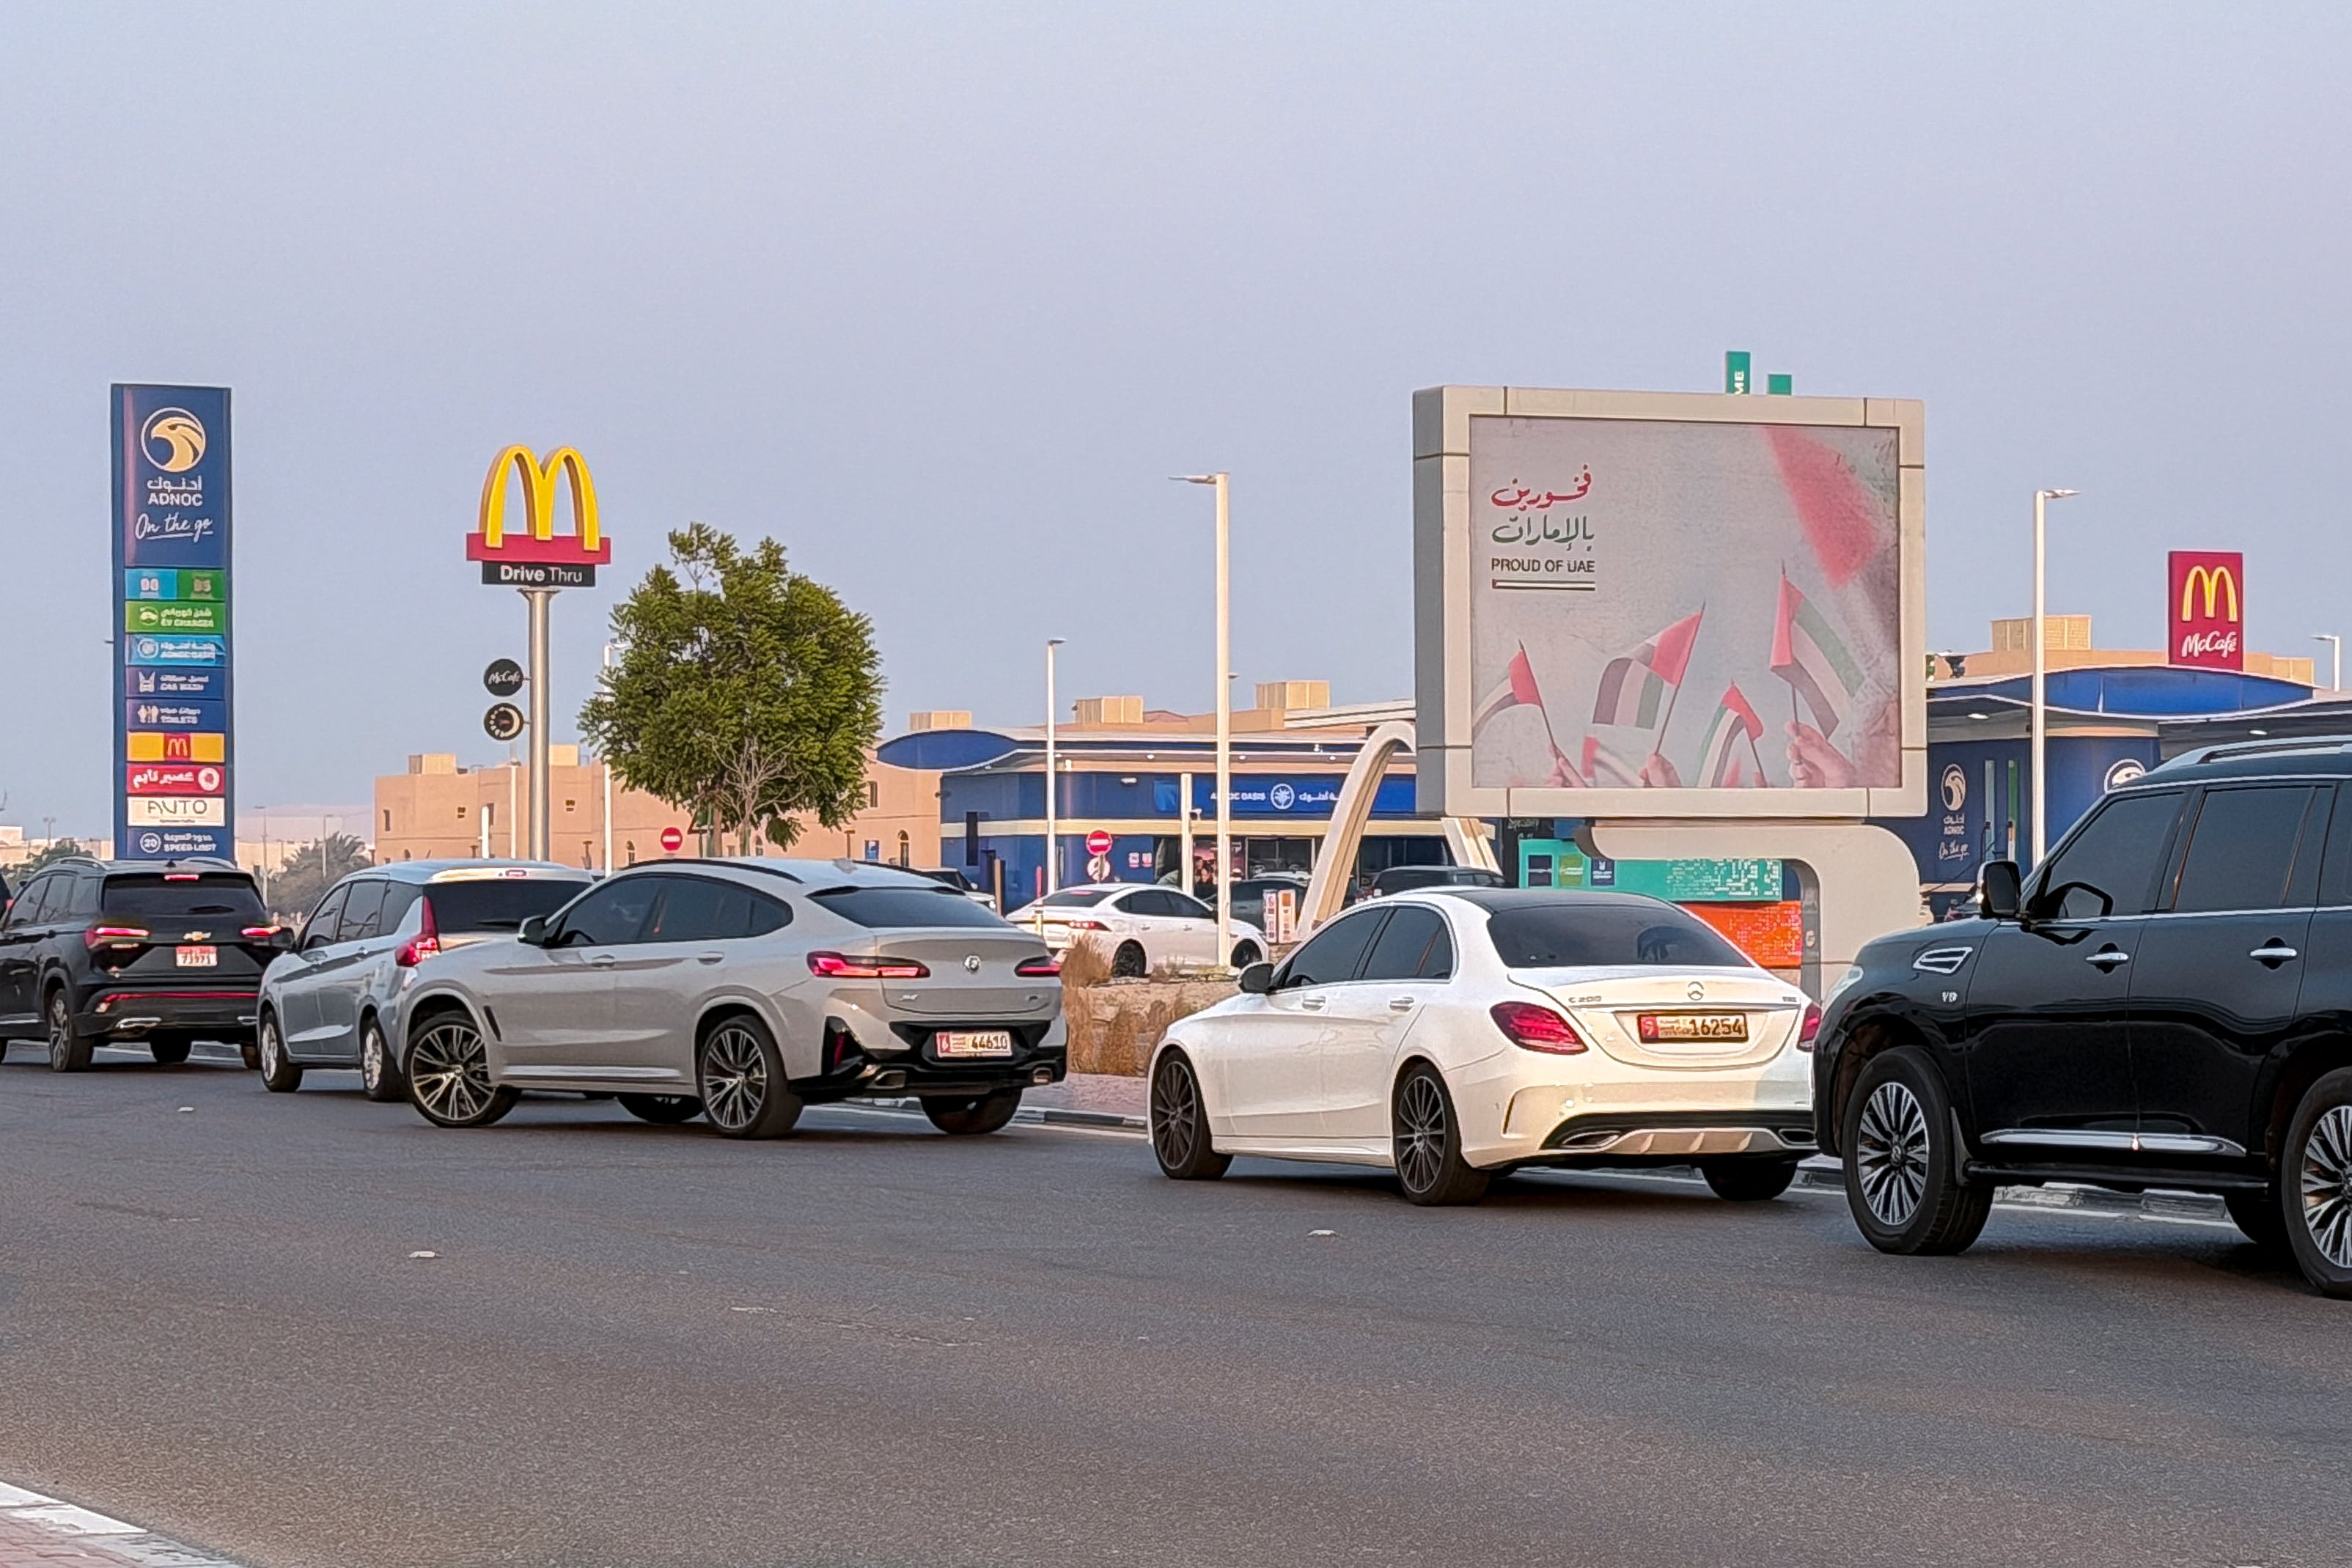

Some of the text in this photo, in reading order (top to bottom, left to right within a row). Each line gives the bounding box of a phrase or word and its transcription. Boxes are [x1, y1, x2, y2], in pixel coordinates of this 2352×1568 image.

[1491, 464, 1591, 512] فخورين
[148, 492, 203, 507] ADNOC
[135, 512, 214, 543] On the go
[1491, 514, 1595, 551] بالإمارات
[500, 564, 583, 584] Drive Thru
[1491, 557, 1595, 573] PROUD OF UAE
[2181, 630, 2238, 658] McCafé
[163, 843, 193, 852] SPEED
[1689, 1018, 1743, 1036] 16254
[971, 1034, 1008, 1050] 44610
